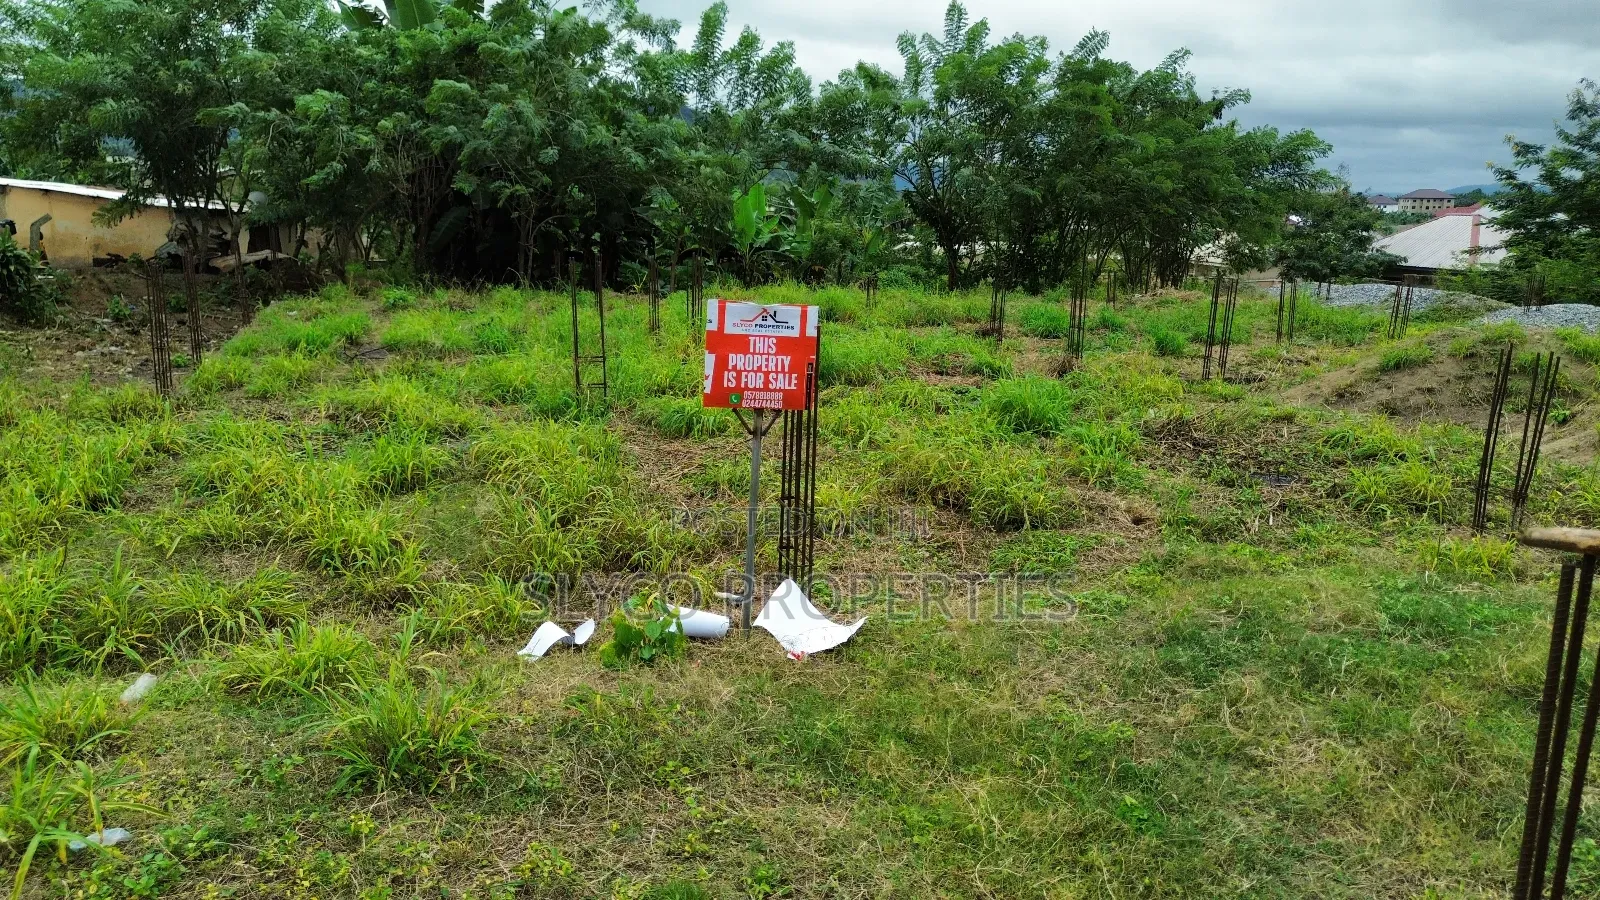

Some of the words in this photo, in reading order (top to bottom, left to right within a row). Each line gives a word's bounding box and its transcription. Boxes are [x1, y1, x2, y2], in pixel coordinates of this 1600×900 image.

[748, 336, 777, 354] THIS
[728, 353, 791, 372] PROPERTY
[723, 370, 737, 388] IS
[740, 371, 764, 389] FOR
[768, 373, 798, 390] SALE
